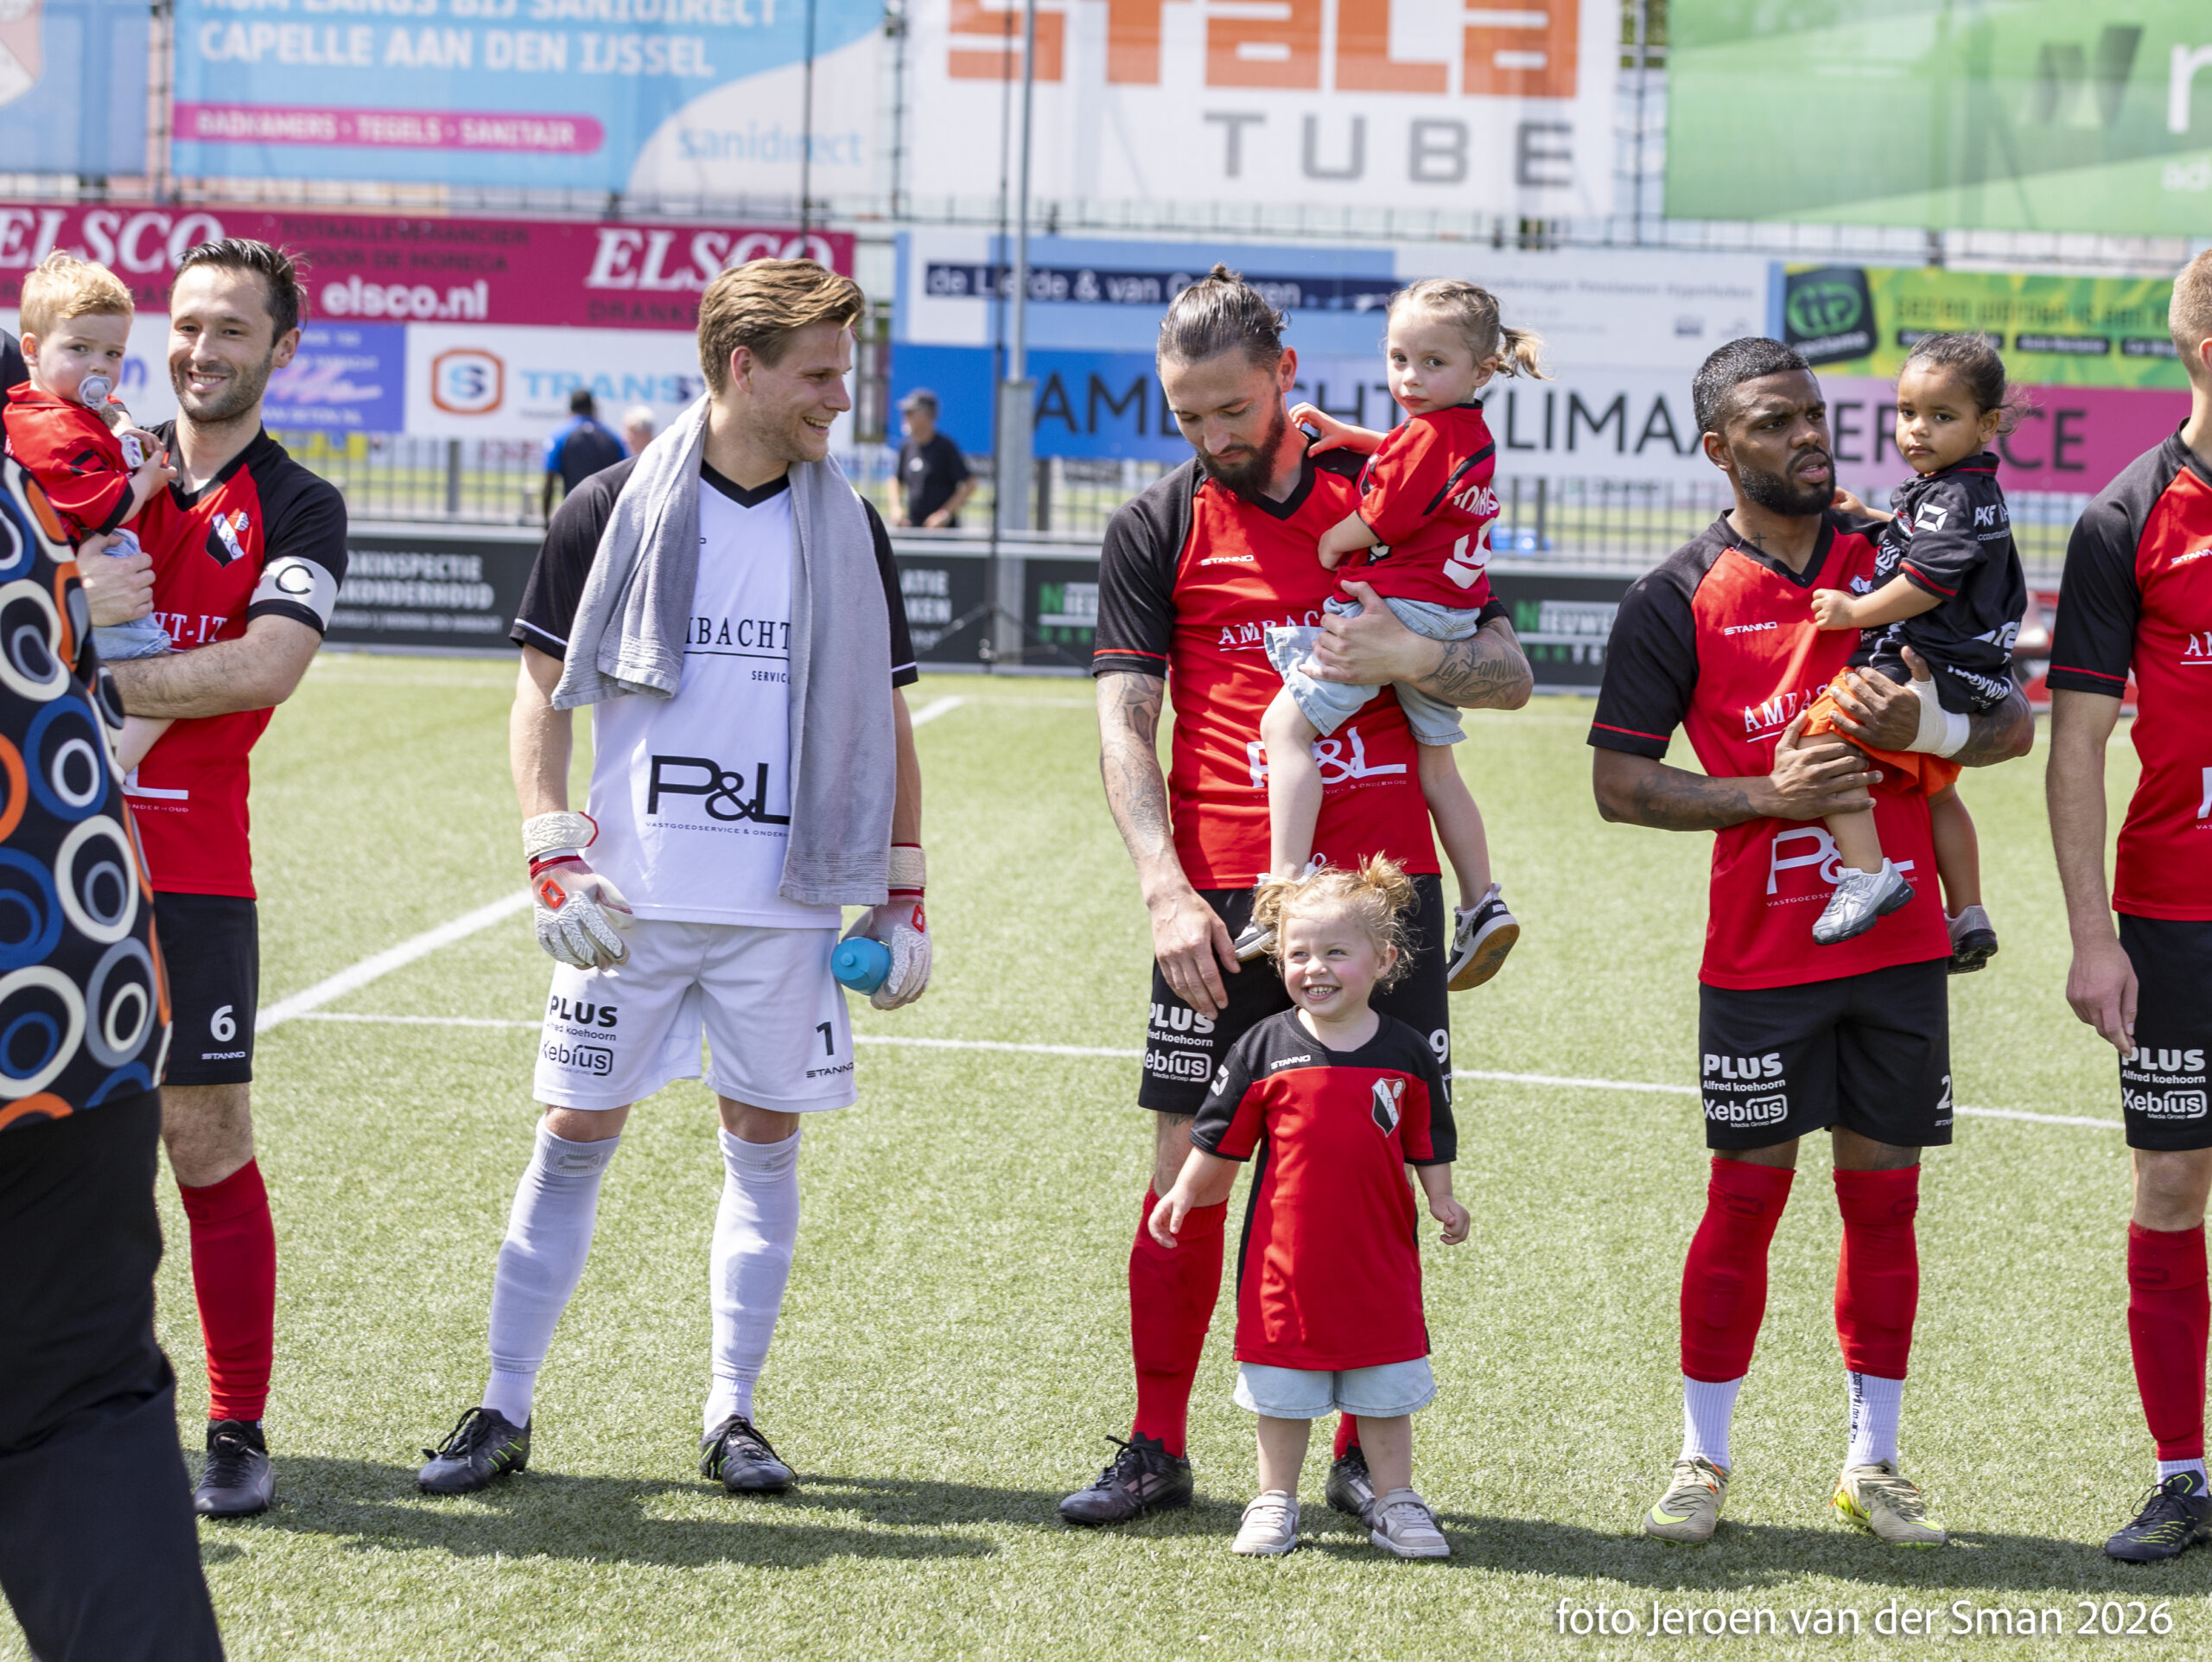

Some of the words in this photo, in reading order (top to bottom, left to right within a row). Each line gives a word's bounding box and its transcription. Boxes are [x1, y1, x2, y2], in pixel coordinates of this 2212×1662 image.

[200, 20, 374, 67] CAPELLE
[383, 26, 474, 69] AAN
[484, 29, 568, 72] DEN
[579, 32, 716, 78] IJSSEL
[195, 109, 338, 142] BADKAMERS
[356, 113, 442, 145] TEGELS
[458, 118, 577, 148] SANITAIR
[1204, 111, 1572, 186] TUBE
[321, 275, 489, 321] elsco.nl
[1201, 554, 1255, 566] STANNO
[275, 564, 315, 595] C
[1724, 621, 1778, 636] STANNO
[751, 670, 791, 685] SERVIC
[647, 755, 791, 826] P&L
[645, 821, 741, 834] VASTGOEDSERVICE
[210, 1004, 237, 1042] 6
[550, 995, 618, 1028] PLUS
[566, 1025, 617, 1041] koehoorn
[816, 1021, 835, 1056] 1
[1161, 1031, 1214, 1048] koehoorn
[201, 1051, 246, 1060] STANNO
[1428, 1028, 1449, 1065] 9
[2121, 1047, 2206, 1072] PLUS
[806, 1061, 854, 1079] STANNO
[1143, 1047, 1205, 1077] ebius
[1270, 1054, 1312, 1070] STANNO
[1703, 1052, 1783, 1079] PLUS
[1702, 1079, 1732, 1092] Alfred
[1732, 1079, 1787, 1092] koehoorn
[2121, 1069, 2151, 1082] Alfred
[2152, 1073, 2207, 1085] koehoorn
[1702, 1098, 1783, 1122] Xebius
[2121, 1086, 2202, 1114] Xebius
